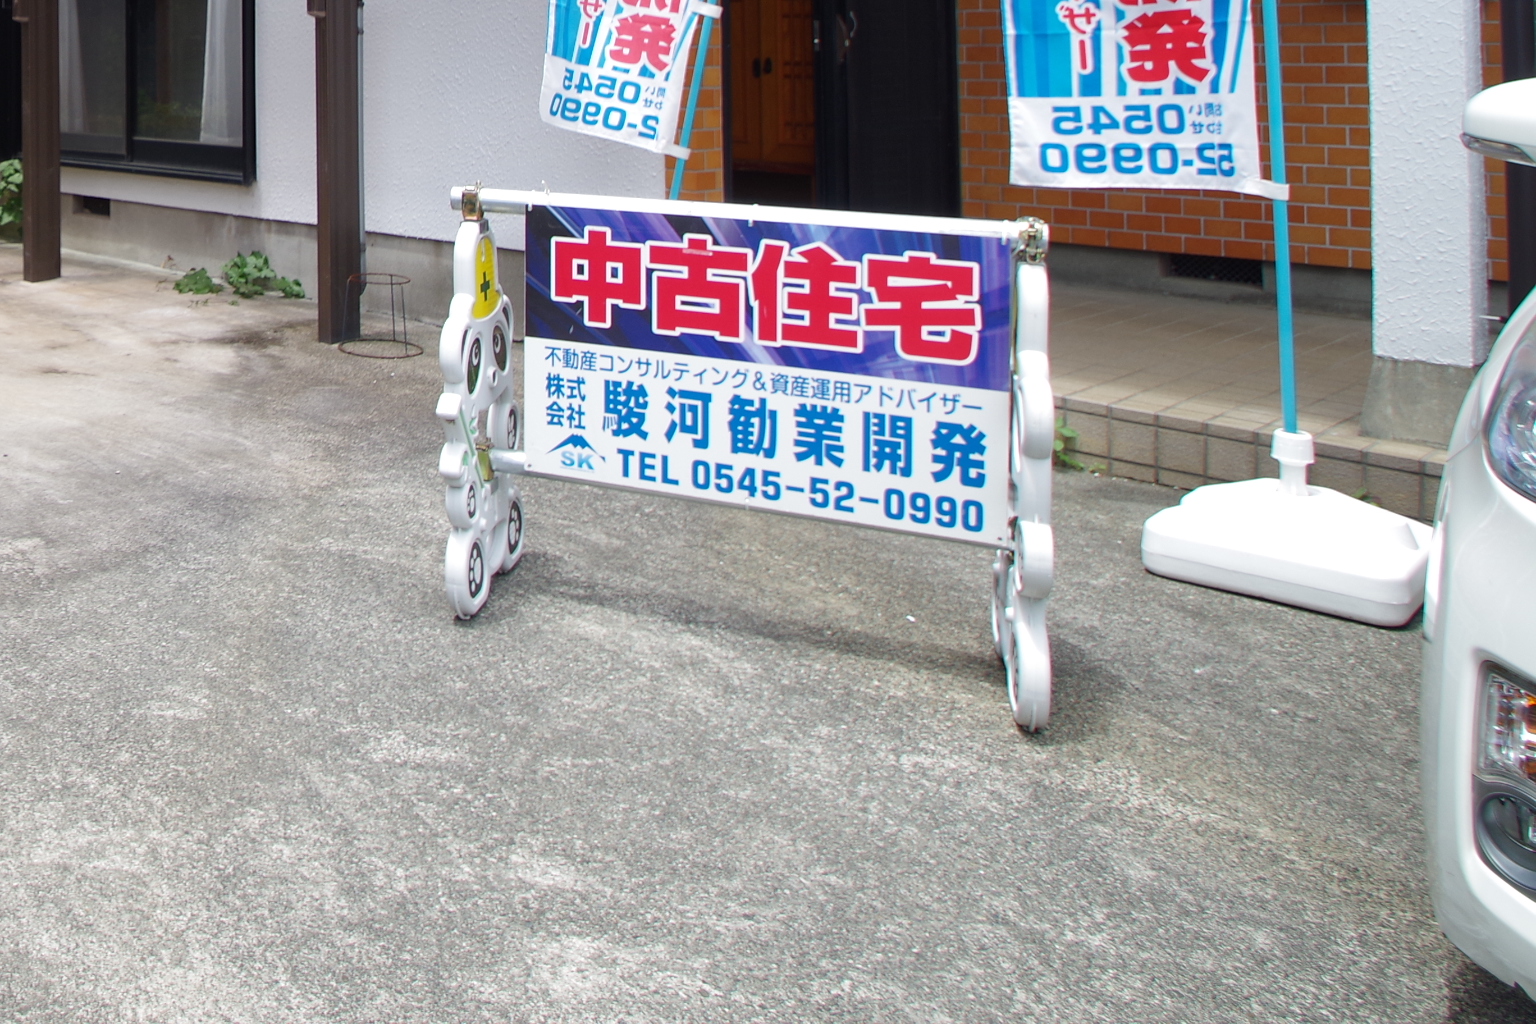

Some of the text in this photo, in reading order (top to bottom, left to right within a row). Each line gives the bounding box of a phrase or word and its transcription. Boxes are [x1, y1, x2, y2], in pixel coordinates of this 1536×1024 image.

[553, 228, 978, 363] 中古住宅
[560, 450, 595, 471] SK
[602, 379, 987, 488] 駿河勧業開発
[616, 447, 985, 533] TEL 0545-52-0990
